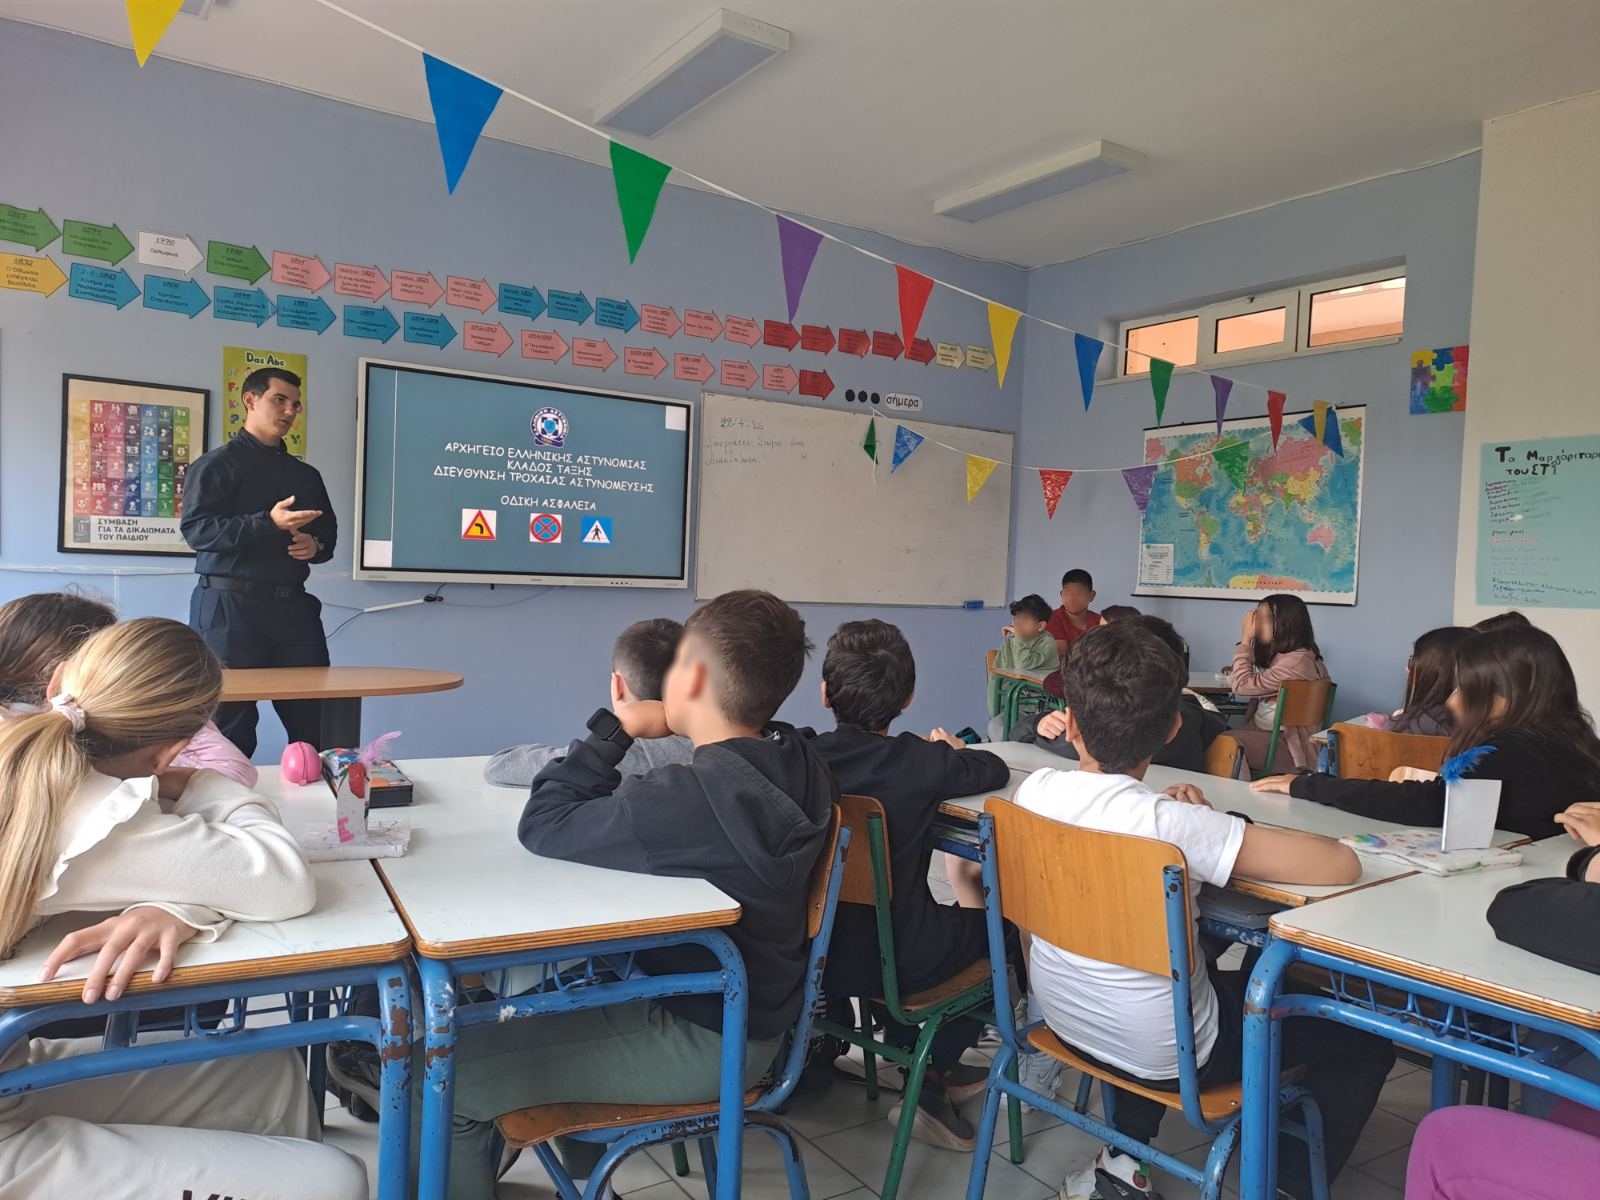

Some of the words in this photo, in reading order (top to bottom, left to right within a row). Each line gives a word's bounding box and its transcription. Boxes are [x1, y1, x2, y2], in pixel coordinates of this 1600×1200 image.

[246, 352, 265, 364] Das
[266, 355, 285, 366] Abc
[886, 394, 919, 408] σήμερα
[444, 442, 505, 458] ΑΡΧΗΓΕΙΟ
[507, 447, 573, 464] ΕΛΛΗΝΙΚΗΣ
[576, 454, 647, 470] ΑΣΤΥΝΟΜΙΑΣ
[507, 460, 552, 474] ΚΛΑΔΟΣ
[557, 464, 593, 477] ΤΑΞΗΣ
[434, 465, 506, 481] ΔΙΕΥΘΥΝΣΗ
[510, 472, 566, 486] ΤΡΟΧΑΙΑΣ
[569, 476, 655, 493] ΑΣΤΥΝΟΜΕΥΣΗΣ
[500, 495, 539, 508] ΟΔΙΚΗ
[541, 498, 597, 511] ΑΣΦΑΛΕΙΑ
[97, 518, 138, 526] ΣΥΜΒΑΣΗ
[126, 526, 176, 534] ΔΙΚΑΙΩΜΑΤΑ
[98, 533, 114, 541] ΤΟΥ
[116, 534, 149, 542] ΠΑΙΔΙΟΥ
